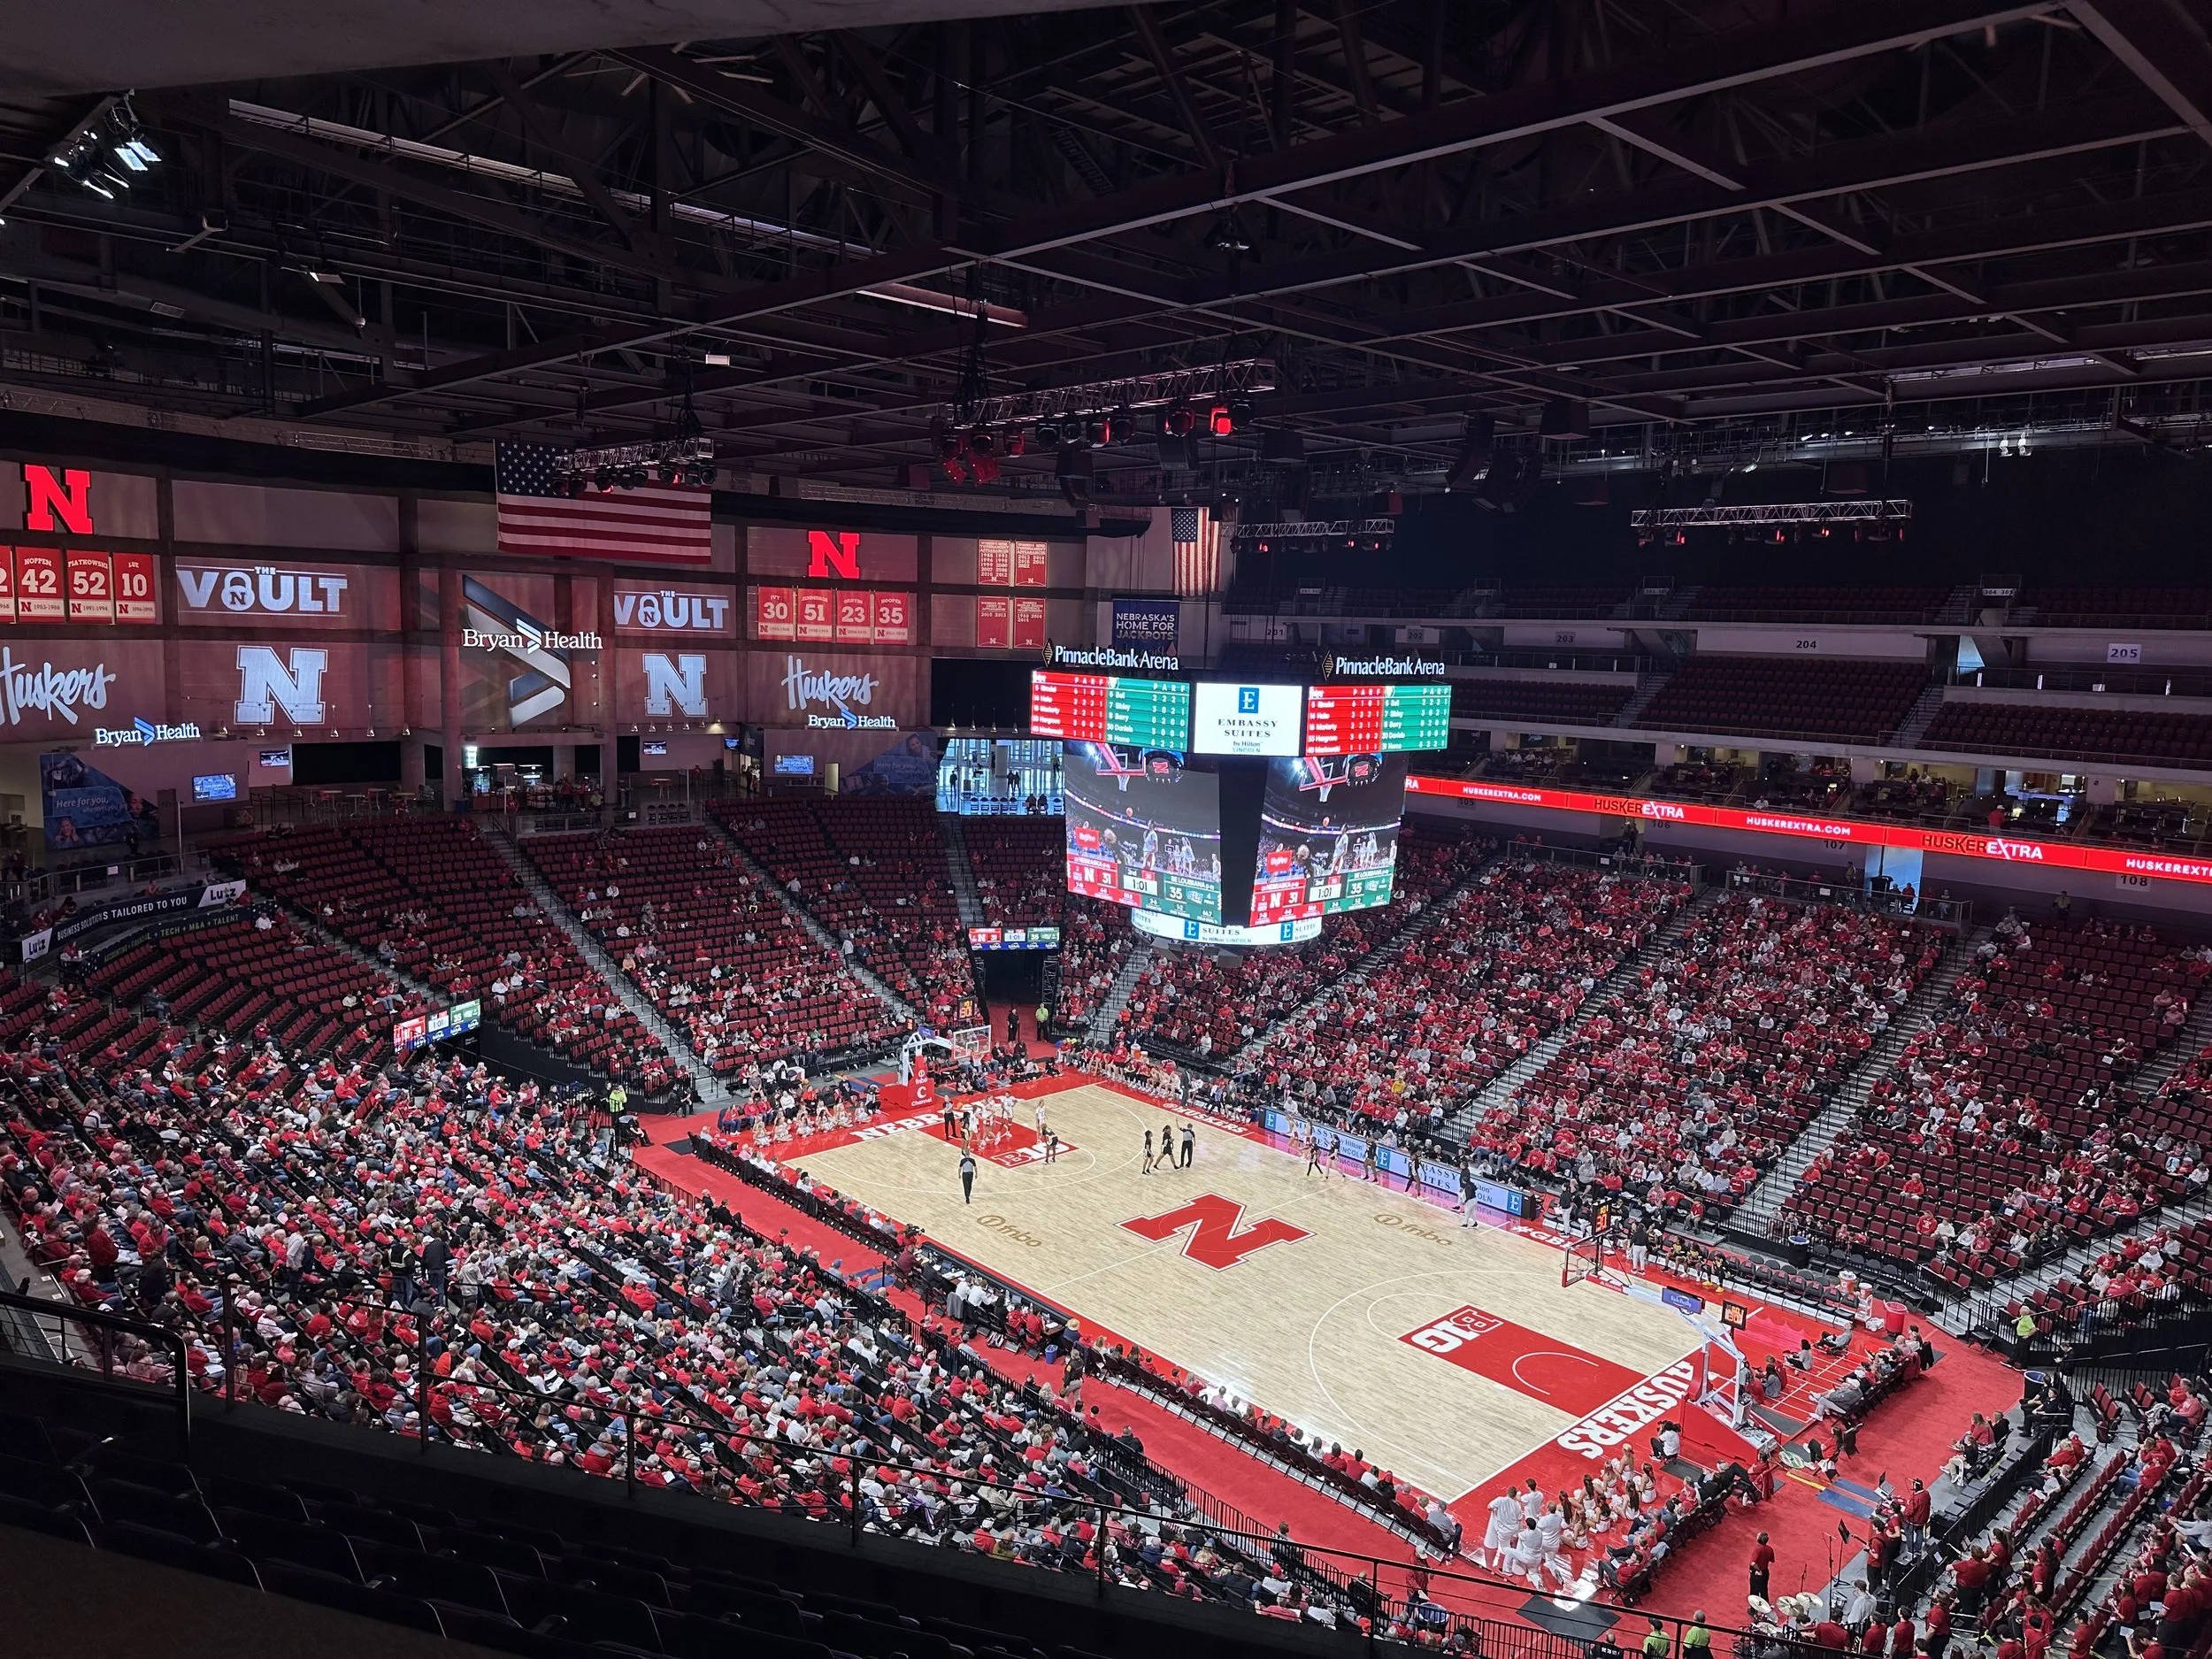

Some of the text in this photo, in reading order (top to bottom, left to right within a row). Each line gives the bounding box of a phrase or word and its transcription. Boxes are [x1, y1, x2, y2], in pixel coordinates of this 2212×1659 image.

[25, 464, 93, 534] N
[25, 557, 51, 566] HOPPEN
[808, 531, 860, 580] N
[67, 558, 109, 570] PIATKOWSKI
[255, 566, 277, 575] THE
[21, 569, 57, 594] 42
[73, 571, 106, 595] 52
[121, 573, 147, 596] 10
[764, 602, 788, 619] 30
[803, 603, 826, 622] 51
[841, 606, 865, 623] 23
[879, 607, 903, 625] 35
[1117, 613, 1175, 622] NEBRASKA'S
[1116, 621, 1174, 631] HOME FOR
[463, 629, 603, 652] Bryan Health
[1117, 630, 1174, 640] JACKPOTS
[1556, 634, 1574, 643] 203
[1796, 640, 1817, 649] 204
[2110, 649, 2138, 658] 205
[234, 645, 328, 726] N
[642, 653, 708, 718] N
[781, 655, 879, 710] Huskers
[808, 715, 896, 731] Bryan Health
[1218, 718, 1278, 727] EMBASSY
[96, 722, 201, 748] Bryan Health
[1463, 786, 1541, 802] HUSKEREXTRA.COM
[77, 798, 90, 807] for
[1651, 819, 1671, 830] 106
[1746, 816, 1851, 836] HUSKEREXTRA.COM
[1824, 840, 1847, 851] 107
[1102, 872, 1111, 884] 31
[1133, 879, 1147, 891] 1:01
[2120, 875, 2147, 886] 108
[1169, 886, 1183, 900] 35
[1318, 888, 1333, 898] 1:01
[1350, 882, 1362, 895] 35
[1288, 891, 1298, 904] 31
[57, 896, 188, 941] BUSINESS SOLUTIONS TAILORED TO YOU
[161, 926, 180, 937] TECH
[213, 914, 240, 926] TALENT
[1295, 923, 1316, 933] SUITES
[911, 1097, 932, 1107] Channel
[1346, 1139, 1363, 1150] Hilton
[996, 1223, 1042, 1248] fnbo
[1114, 1191, 1317, 1272] N
[1401, 1224, 1452, 1246] fnbo
